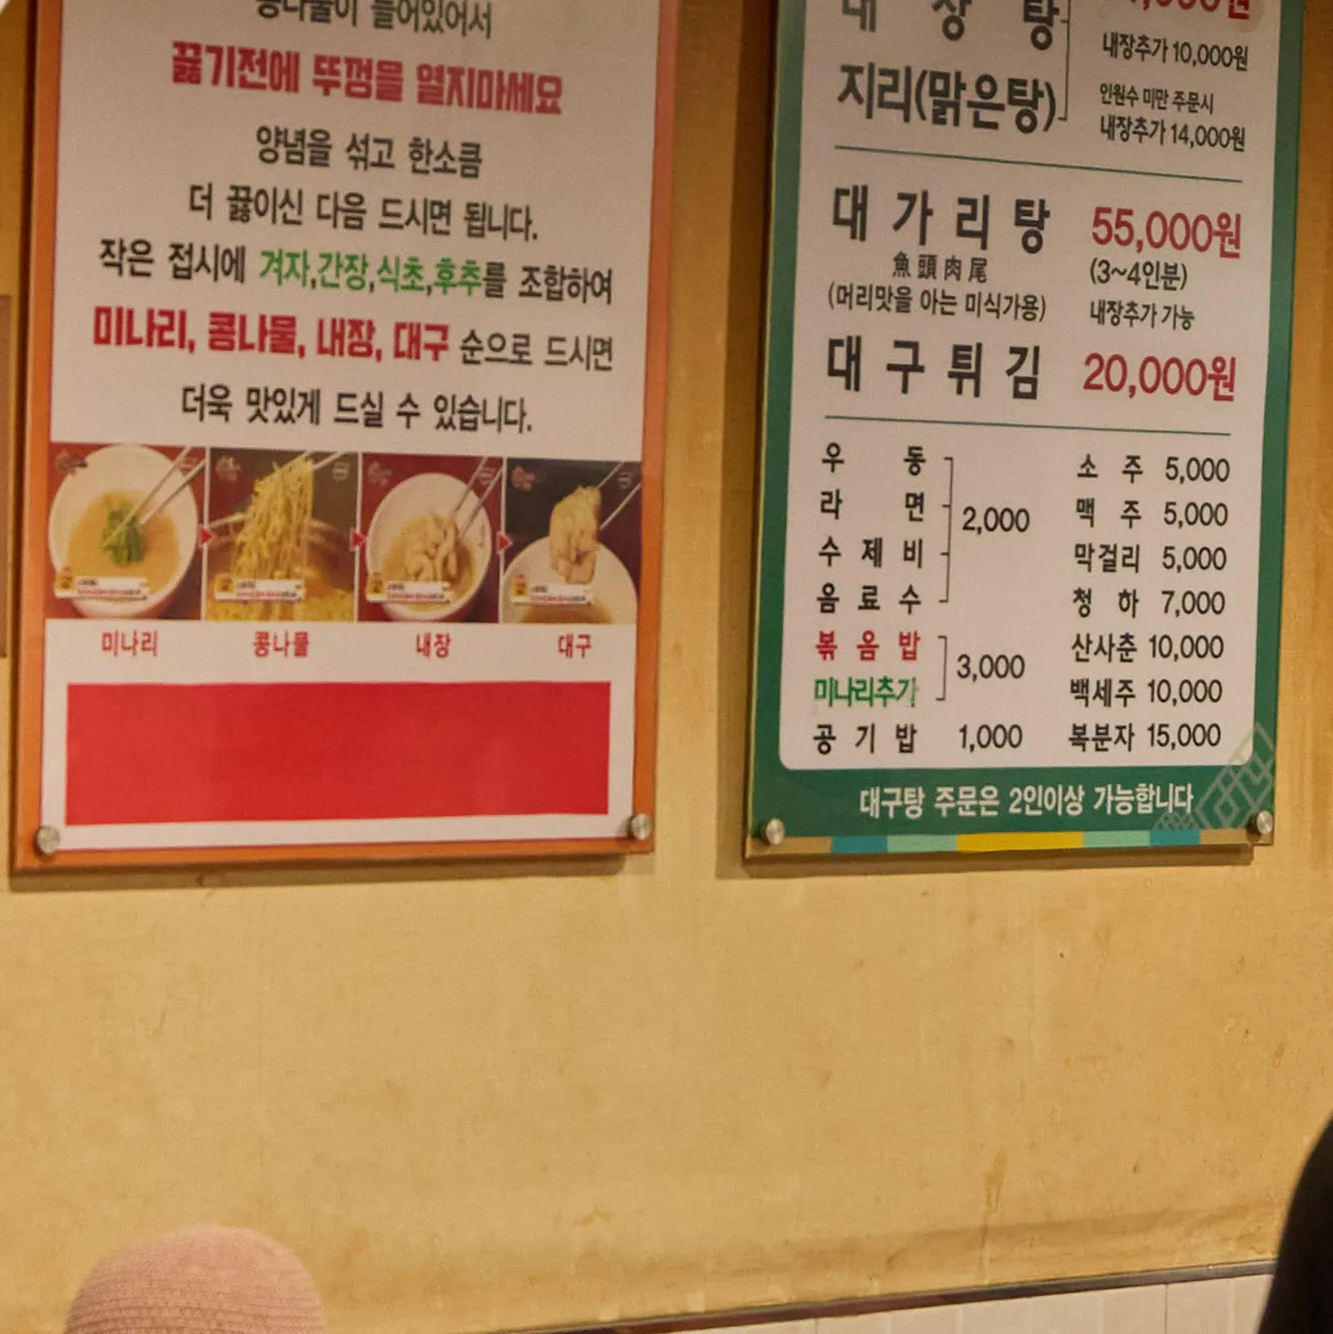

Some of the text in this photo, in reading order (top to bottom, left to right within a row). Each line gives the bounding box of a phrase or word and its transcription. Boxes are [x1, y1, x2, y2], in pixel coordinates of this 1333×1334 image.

[371, 0, 491, 39] 들어있어서
[1102, 31, 1248, 72] 내장추가 10,000원
[312, 53, 403, 102] 뚜껑을
[416, 62, 563, 115] 열지마세요
[837, 61, 1056, 134] 지리(맑은탕)
[1099, 83, 1214, 115] 인원수 미만 주문시
[1100, 115, 1245, 152] 내장추가 14,000원
[256, 125, 483, 179] 양념을 섞고 한소큼
[189, 182, 538, 241] 더 끓이신 다음 드시면 됩니다.
[1091, 206, 1241, 259] 55,000원
[99, 238, 155, 277] 작은
[168, 242, 247, 284] 접시에
[518, 264, 613, 306] 조합하여
[1090, 257, 1188, 291] (3~4인분)
[828, 281, 1046, 322] (머리맛을 아는 미식가용)
[1090, 299, 1195, 331] 내장추가 가능
[93, 305, 613, 372] 미나리, 콩나물, 내장, 대구 순으로 드시면
[1083, 352, 1236, 402] 20,000원
[182, 383, 532, 433] 더욱 맛있게 드실 수 있습니다.
[1165, 456, 1230, 484] 5,000
[962, 505, 1030, 535] 2,000
[1163, 501, 1228, 529] 5,000
[1074, 543, 1227, 573] 막걸리 5,000
[1161, 590, 1226, 618] 7,000
[101, 629, 158, 657] 미나리
[252, 630, 310, 657] 콩나물
[416, 632, 451, 658] 내장
[557, 633, 592, 658] 대구
[1071, 632, 1224, 663] 산사춘 10,000
[814, 653, 1026, 708] 미나리추가 3,000
[1070, 677, 1223, 708] 백세주 10,000
[959, 724, 1023, 753] 1,000
[1068, 722, 1221, 752] 복분자 15,000
[860, 782, 1194, 819] 대구탕 주문은 2인이상 가능합니다
